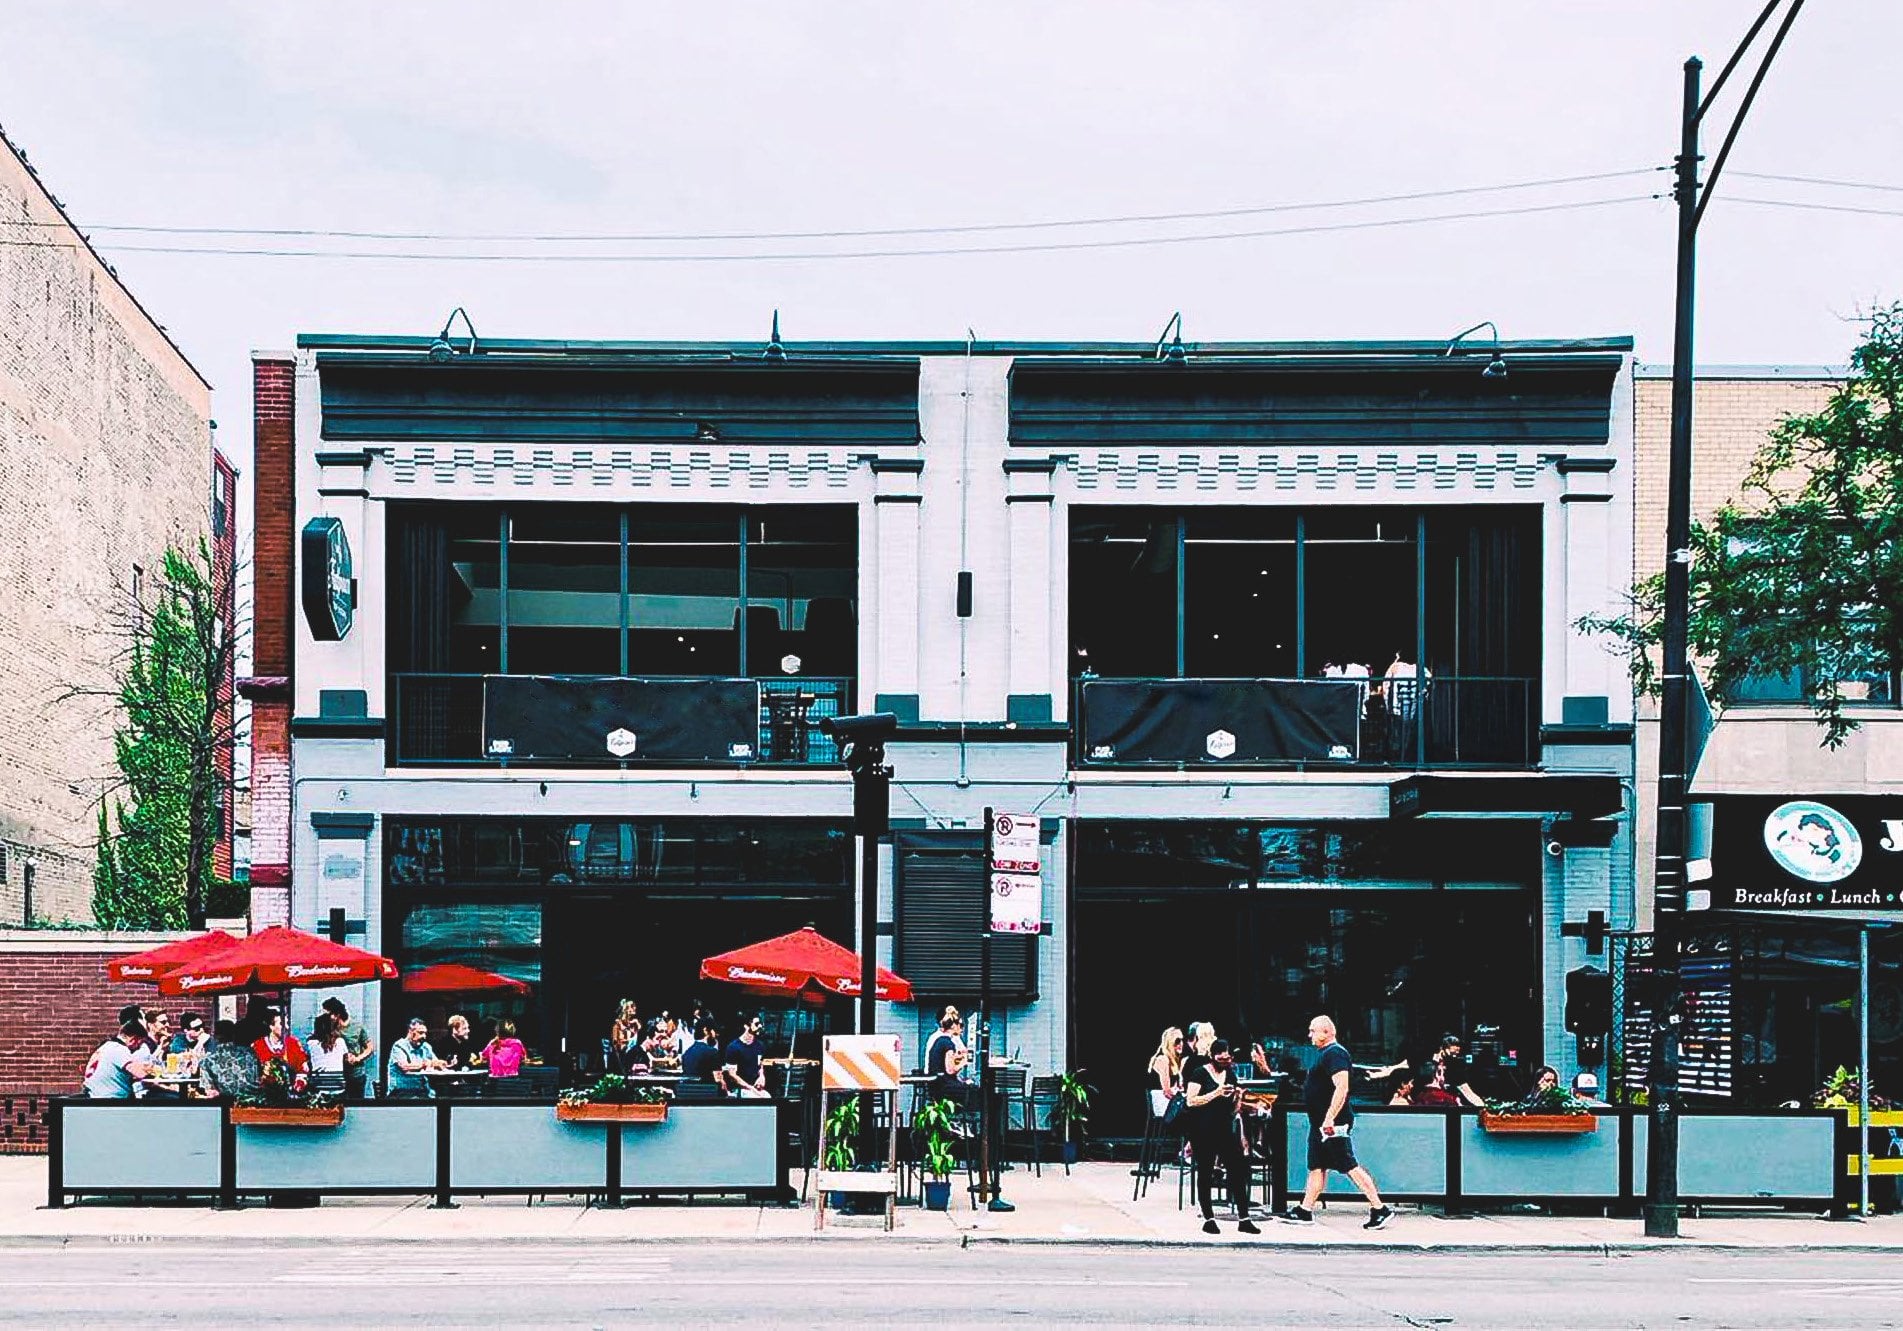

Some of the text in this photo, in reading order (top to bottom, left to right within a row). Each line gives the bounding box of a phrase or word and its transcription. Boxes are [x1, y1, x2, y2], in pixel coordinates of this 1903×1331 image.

[1735, 888, 1812, 906] Breakfast
[1831, 889, 1881, 904] Lunch
[284, 965, 351, 977] Budweiser
